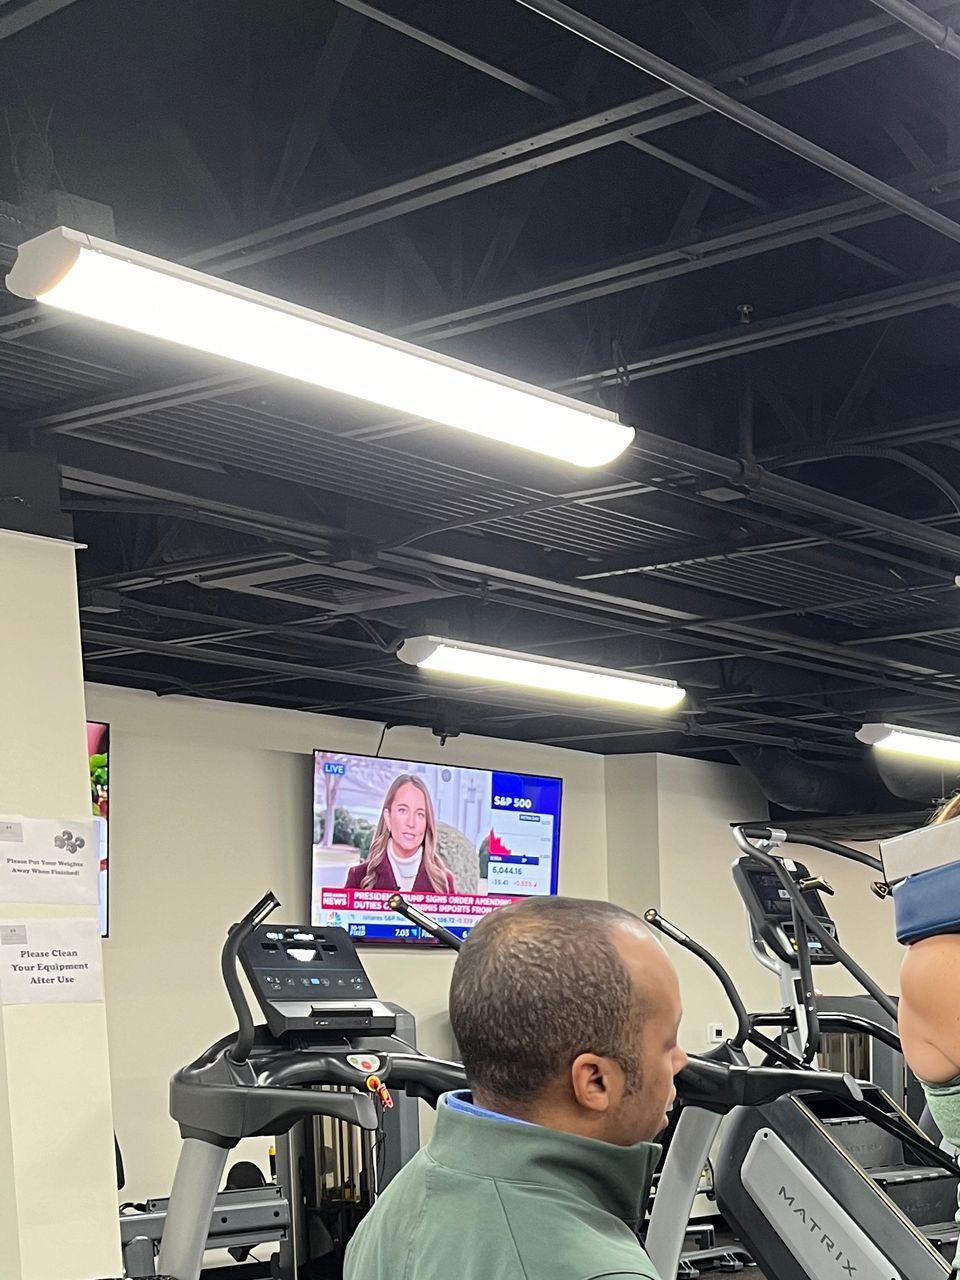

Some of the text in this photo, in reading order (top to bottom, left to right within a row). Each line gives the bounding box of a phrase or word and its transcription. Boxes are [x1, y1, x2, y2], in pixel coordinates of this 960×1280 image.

[325, 764, 344, 774] LIVE
[494, 796, 532, 808] S&P 500
[58, 860, 83, 868] Weights
[323, 897, 347, 906] NEWS
[425, 895, 447, 904] SIGNS
[448, 896, 474, 905] ORDER
[354, 901, 382, 910] DUTIES
[439, 904, 471, 913] IMPORTS
[471, 905, 493, 914] FROM
[395, 929, 410, 937] 7.03
[20, 949, 78, 958] Please Clean
[11, 963, 89, 973] Your Equipment
[30, 976, 75, 984] After Use
[778, 1185, 857, 1278] MATRIX
